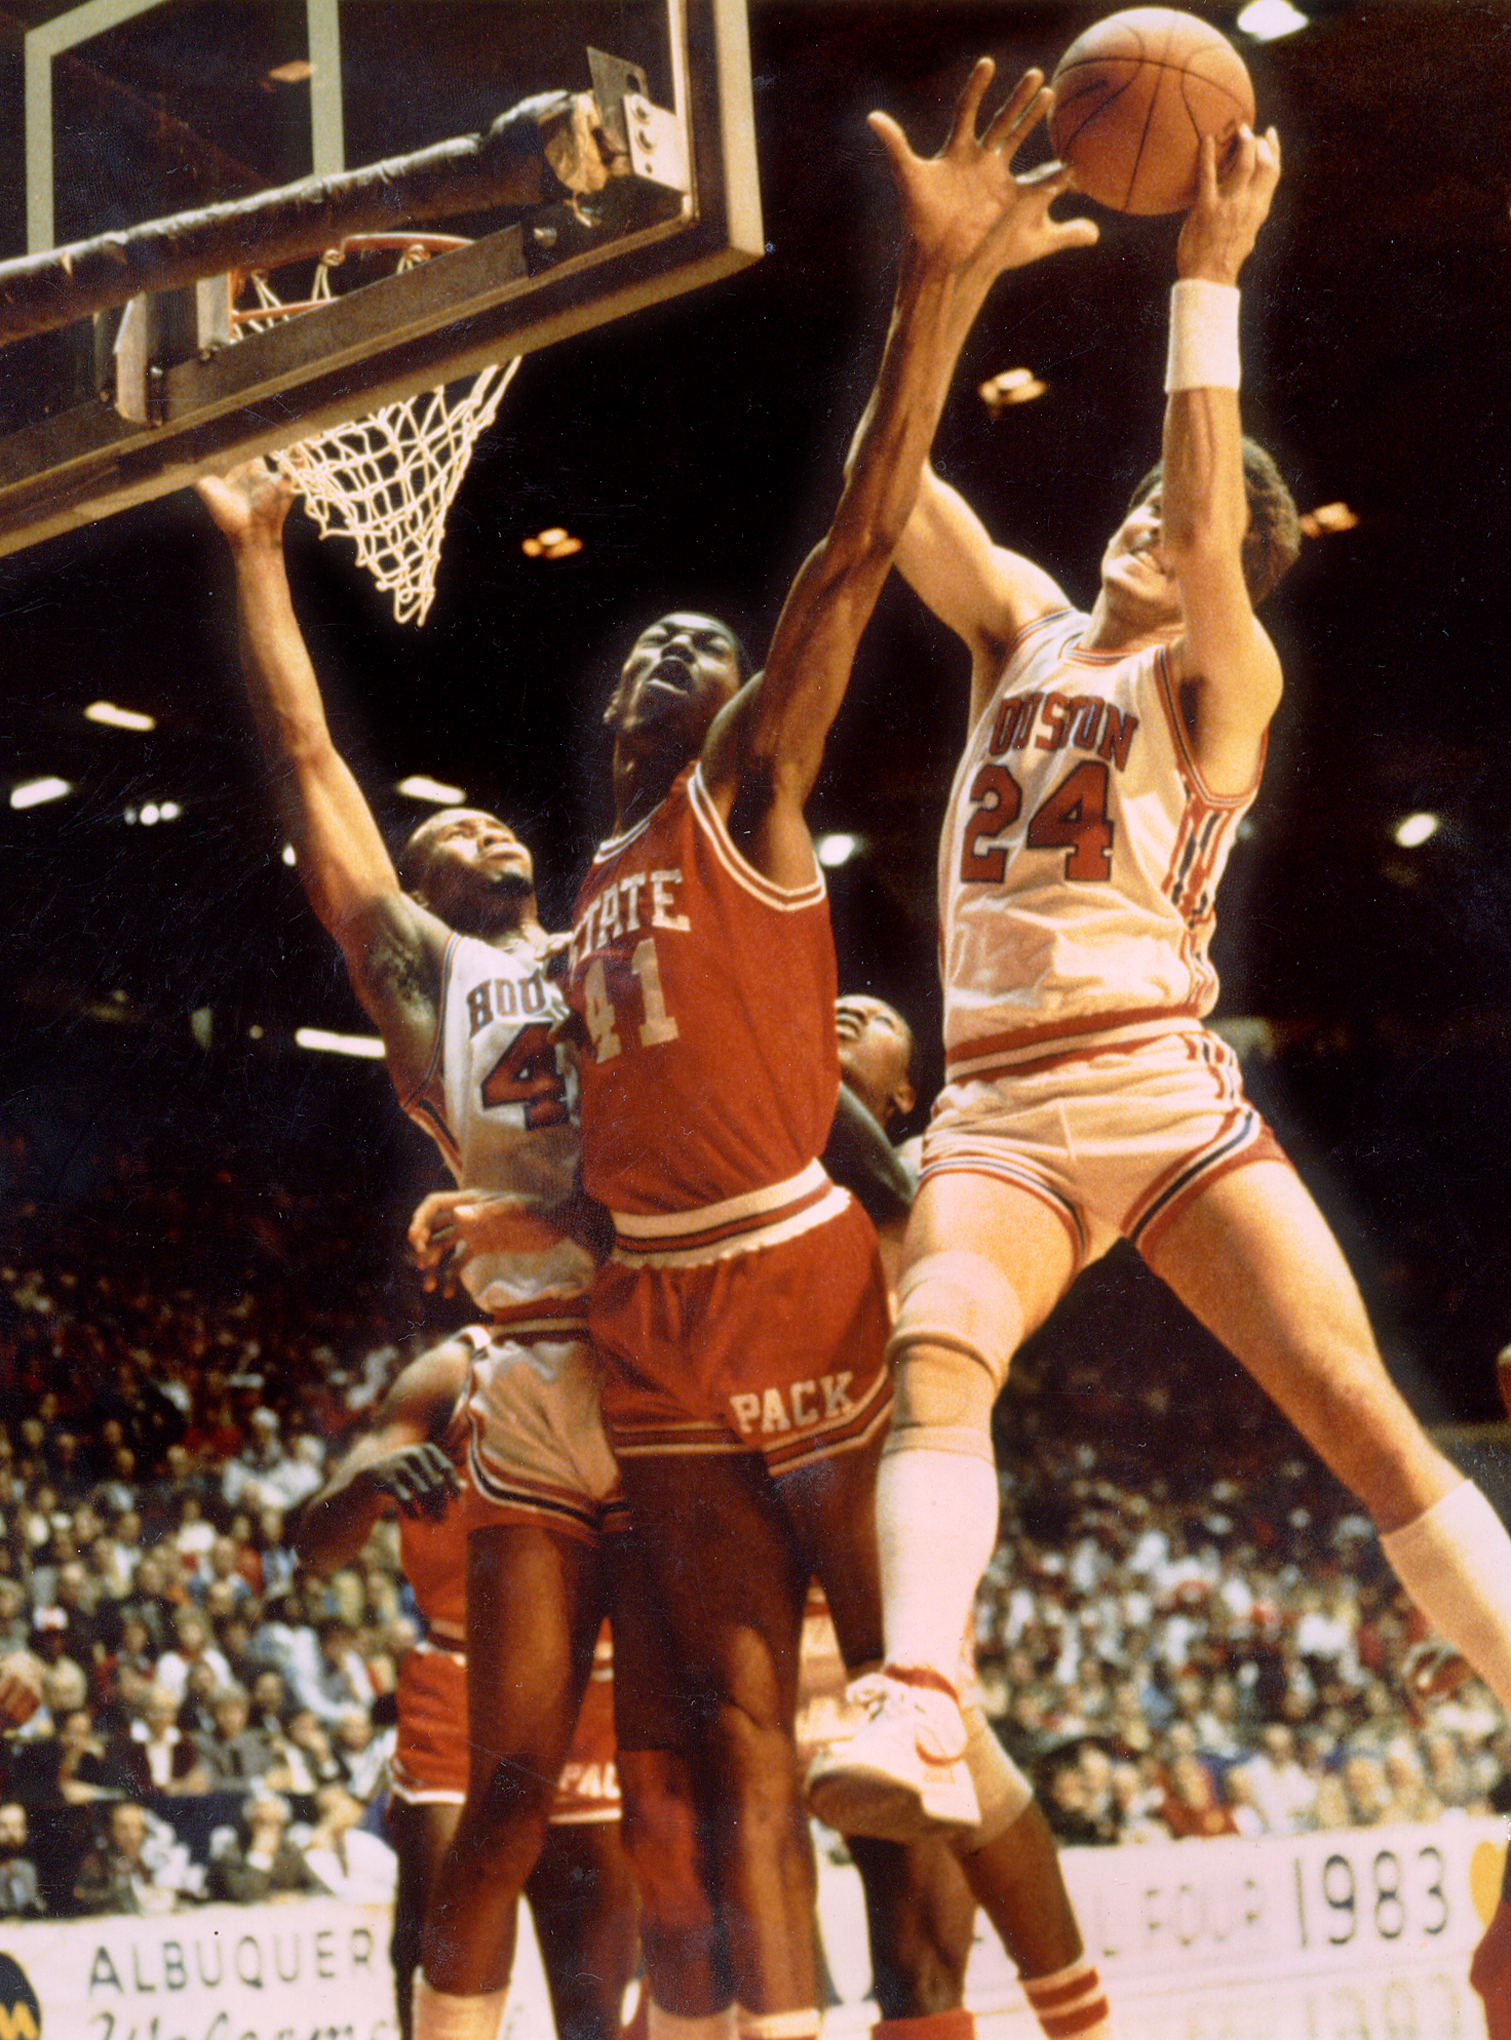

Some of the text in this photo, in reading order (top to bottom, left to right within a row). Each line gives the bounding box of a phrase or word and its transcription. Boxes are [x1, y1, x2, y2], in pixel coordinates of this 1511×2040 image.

[959, 759, 1115, 885] 24
[584, 937, 680, 1064] 41
[729, 1370, 857, 1434] PACK
[1293, 1845, 1449, 1950] 1983
